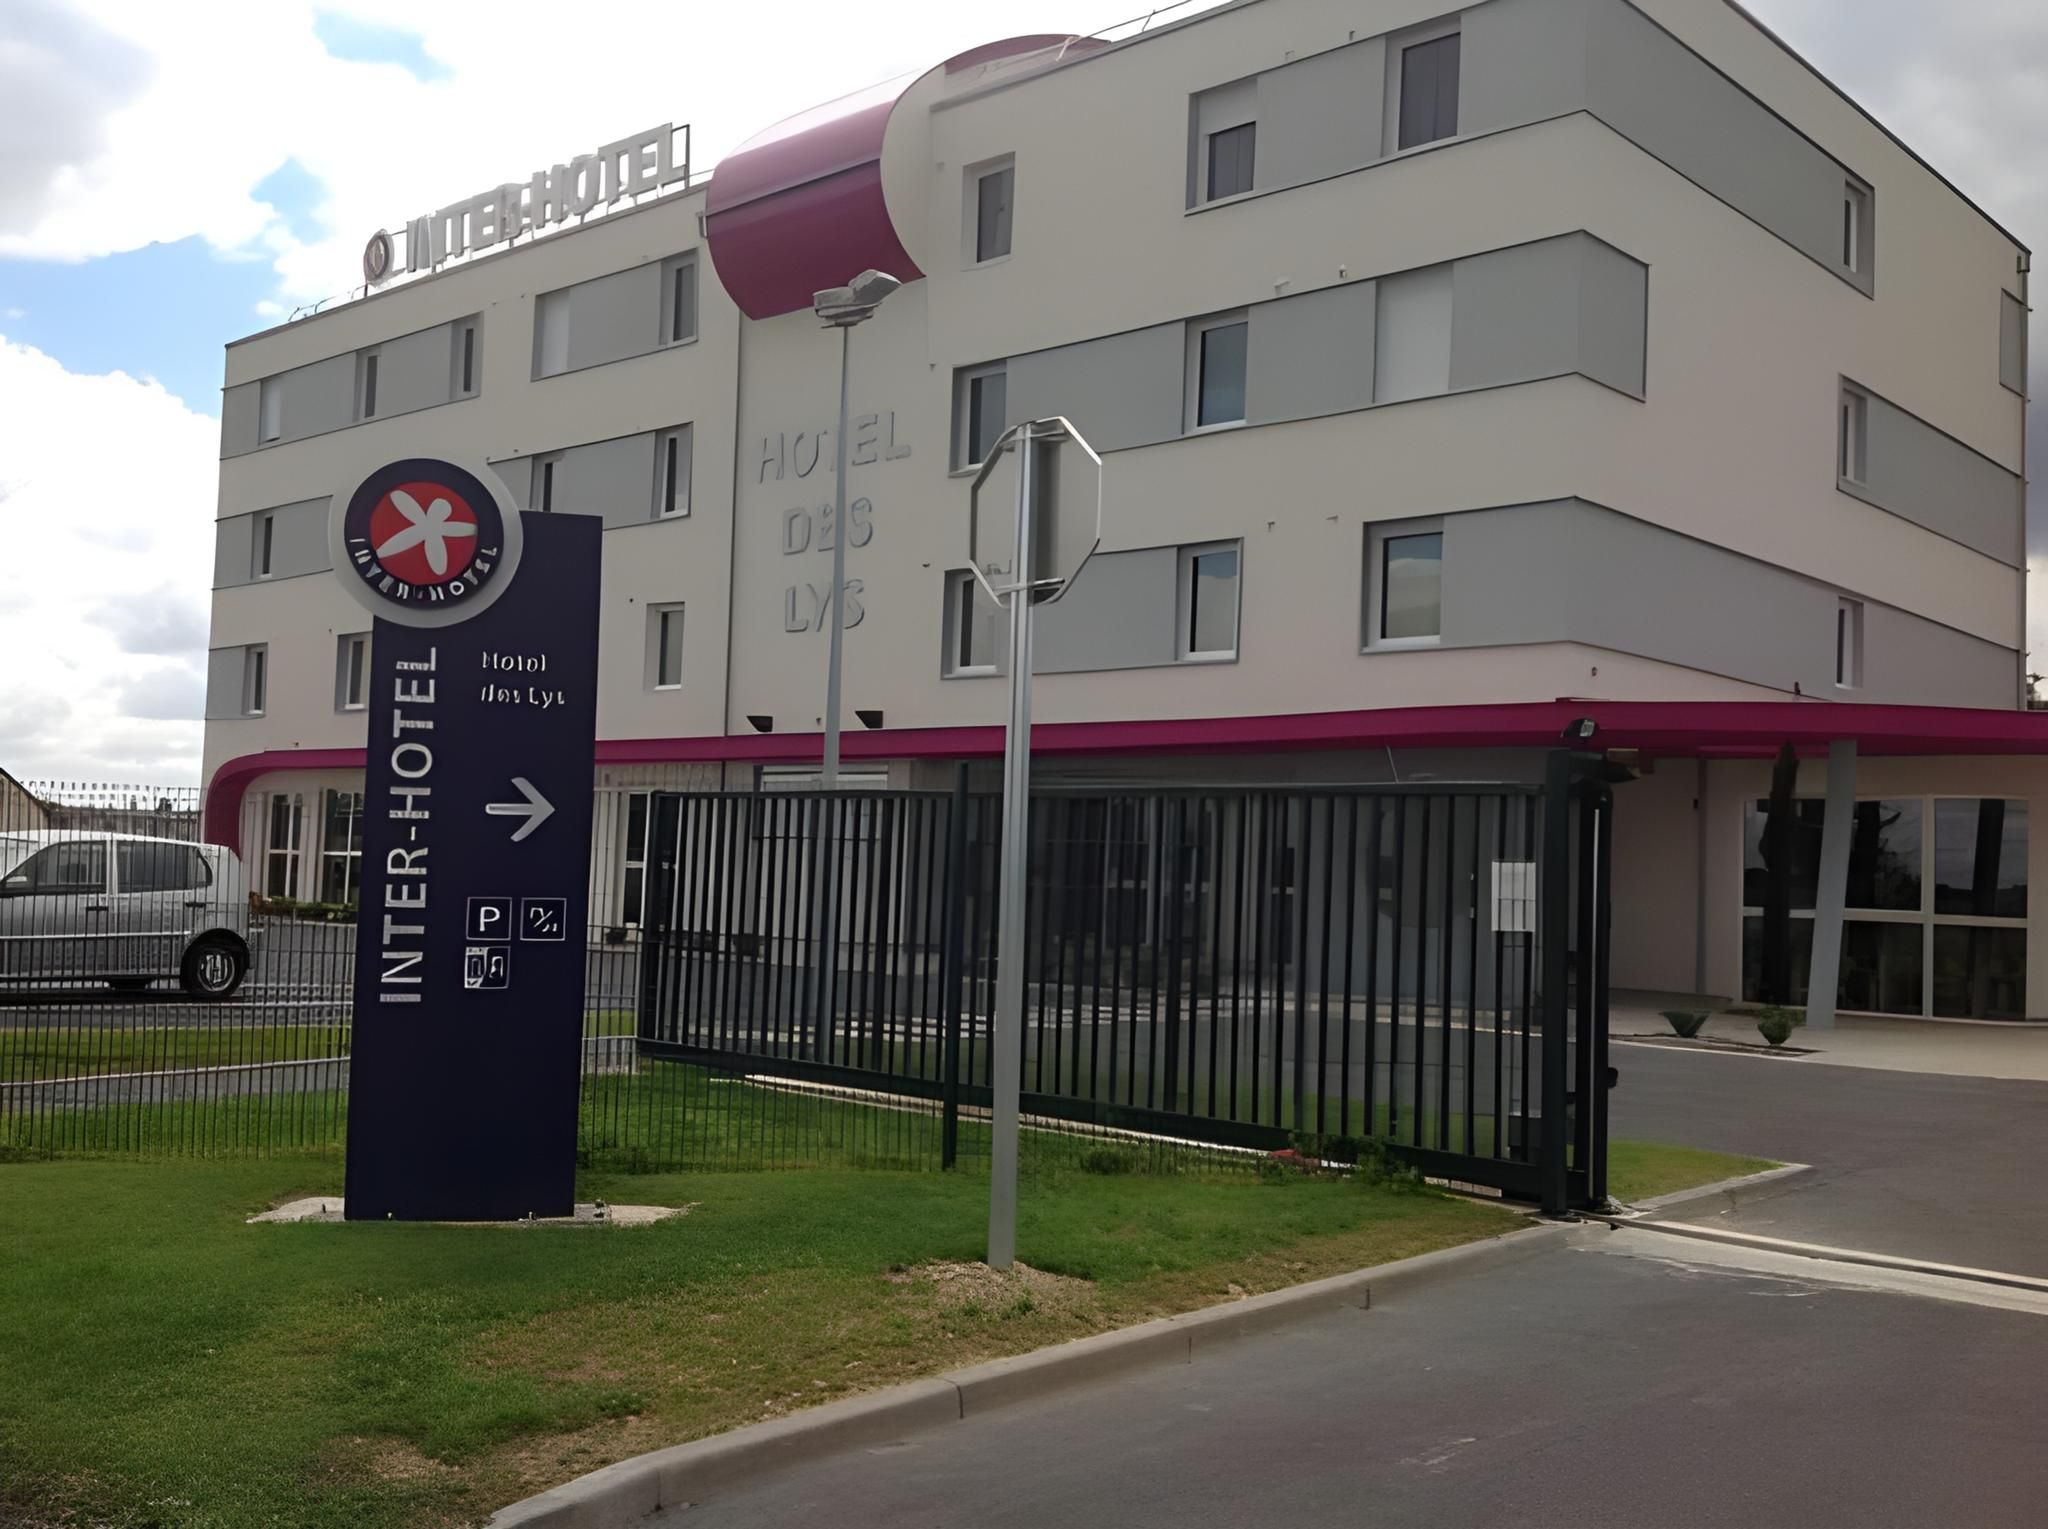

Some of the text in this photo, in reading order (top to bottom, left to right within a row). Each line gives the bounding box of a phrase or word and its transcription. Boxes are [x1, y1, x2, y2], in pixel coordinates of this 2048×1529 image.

[759, 411, 911, 484] HOEL
[379, 646, 436, 1003] INTER-HOTEL
[479, 906, 502, 932] P
